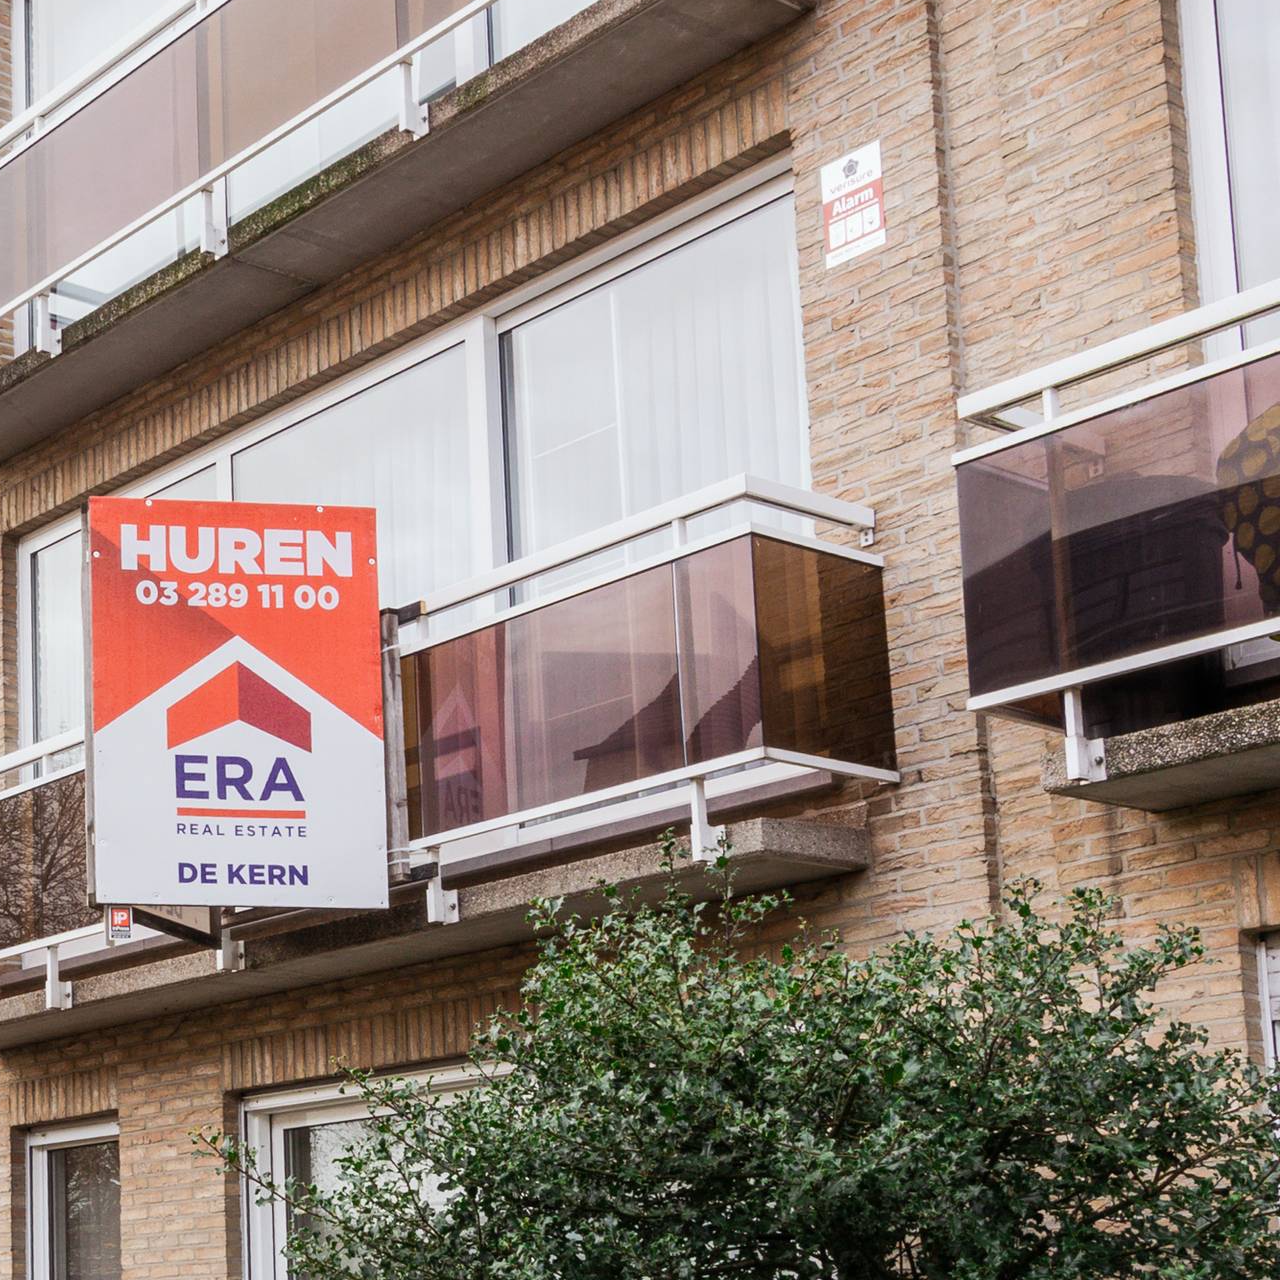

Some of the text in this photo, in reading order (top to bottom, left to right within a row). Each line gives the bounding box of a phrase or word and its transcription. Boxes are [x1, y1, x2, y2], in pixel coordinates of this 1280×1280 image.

[830, 169, 873, 194] verisure
[832, 187, 874, 217] Alarm
[120, 524, 353, 577] HUREN
[136, 580, 340, 611] 03 289 11 00
[175, 754, 305, 801] ERA
[176, 823, 307, 837] REAL ESTATE
[178, 862, 309, 885] DE KERN
